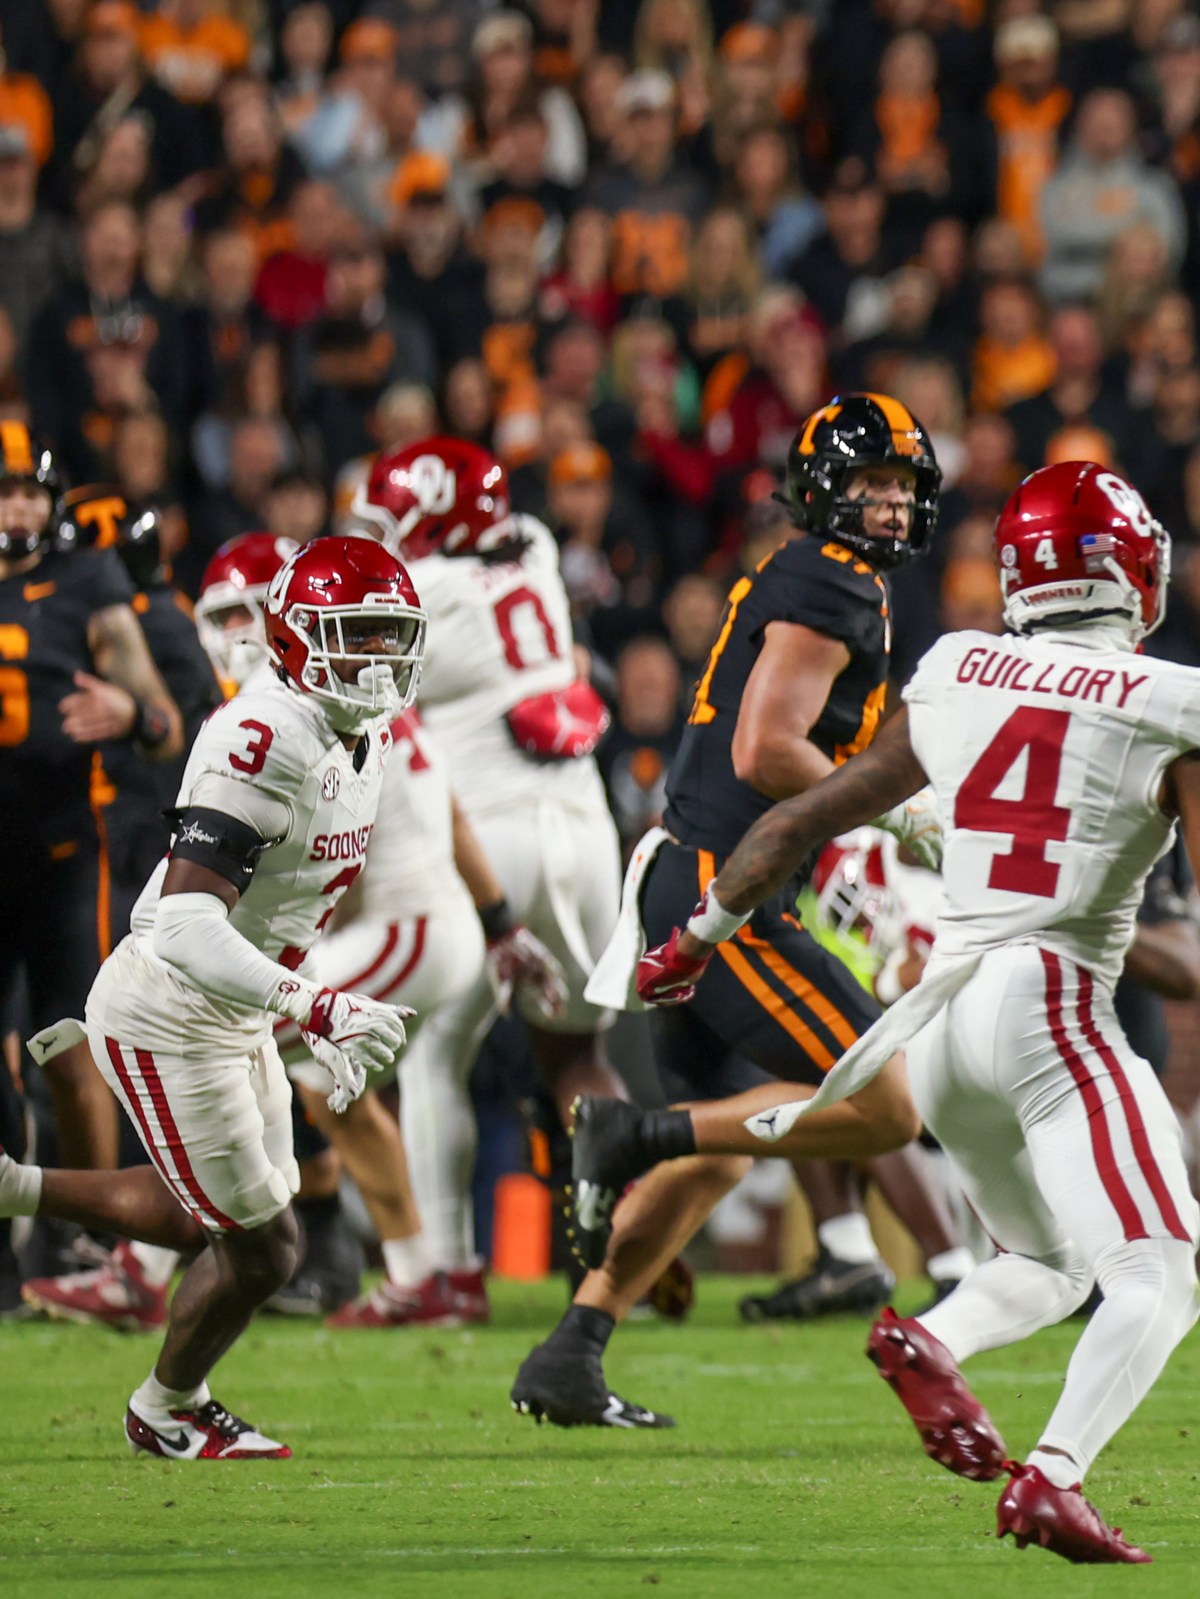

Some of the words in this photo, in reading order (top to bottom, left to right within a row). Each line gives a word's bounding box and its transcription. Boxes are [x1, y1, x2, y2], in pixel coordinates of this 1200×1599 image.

[75, 496, 128, 549] T
[1034, 538, 1060, 570] 4
[955, 647, 1150, 709] GUILLORY
[228, 718, 274, 775] 3
[953, 704, 1073, 899] 4
[308, 823, 374, 862] SOONE
